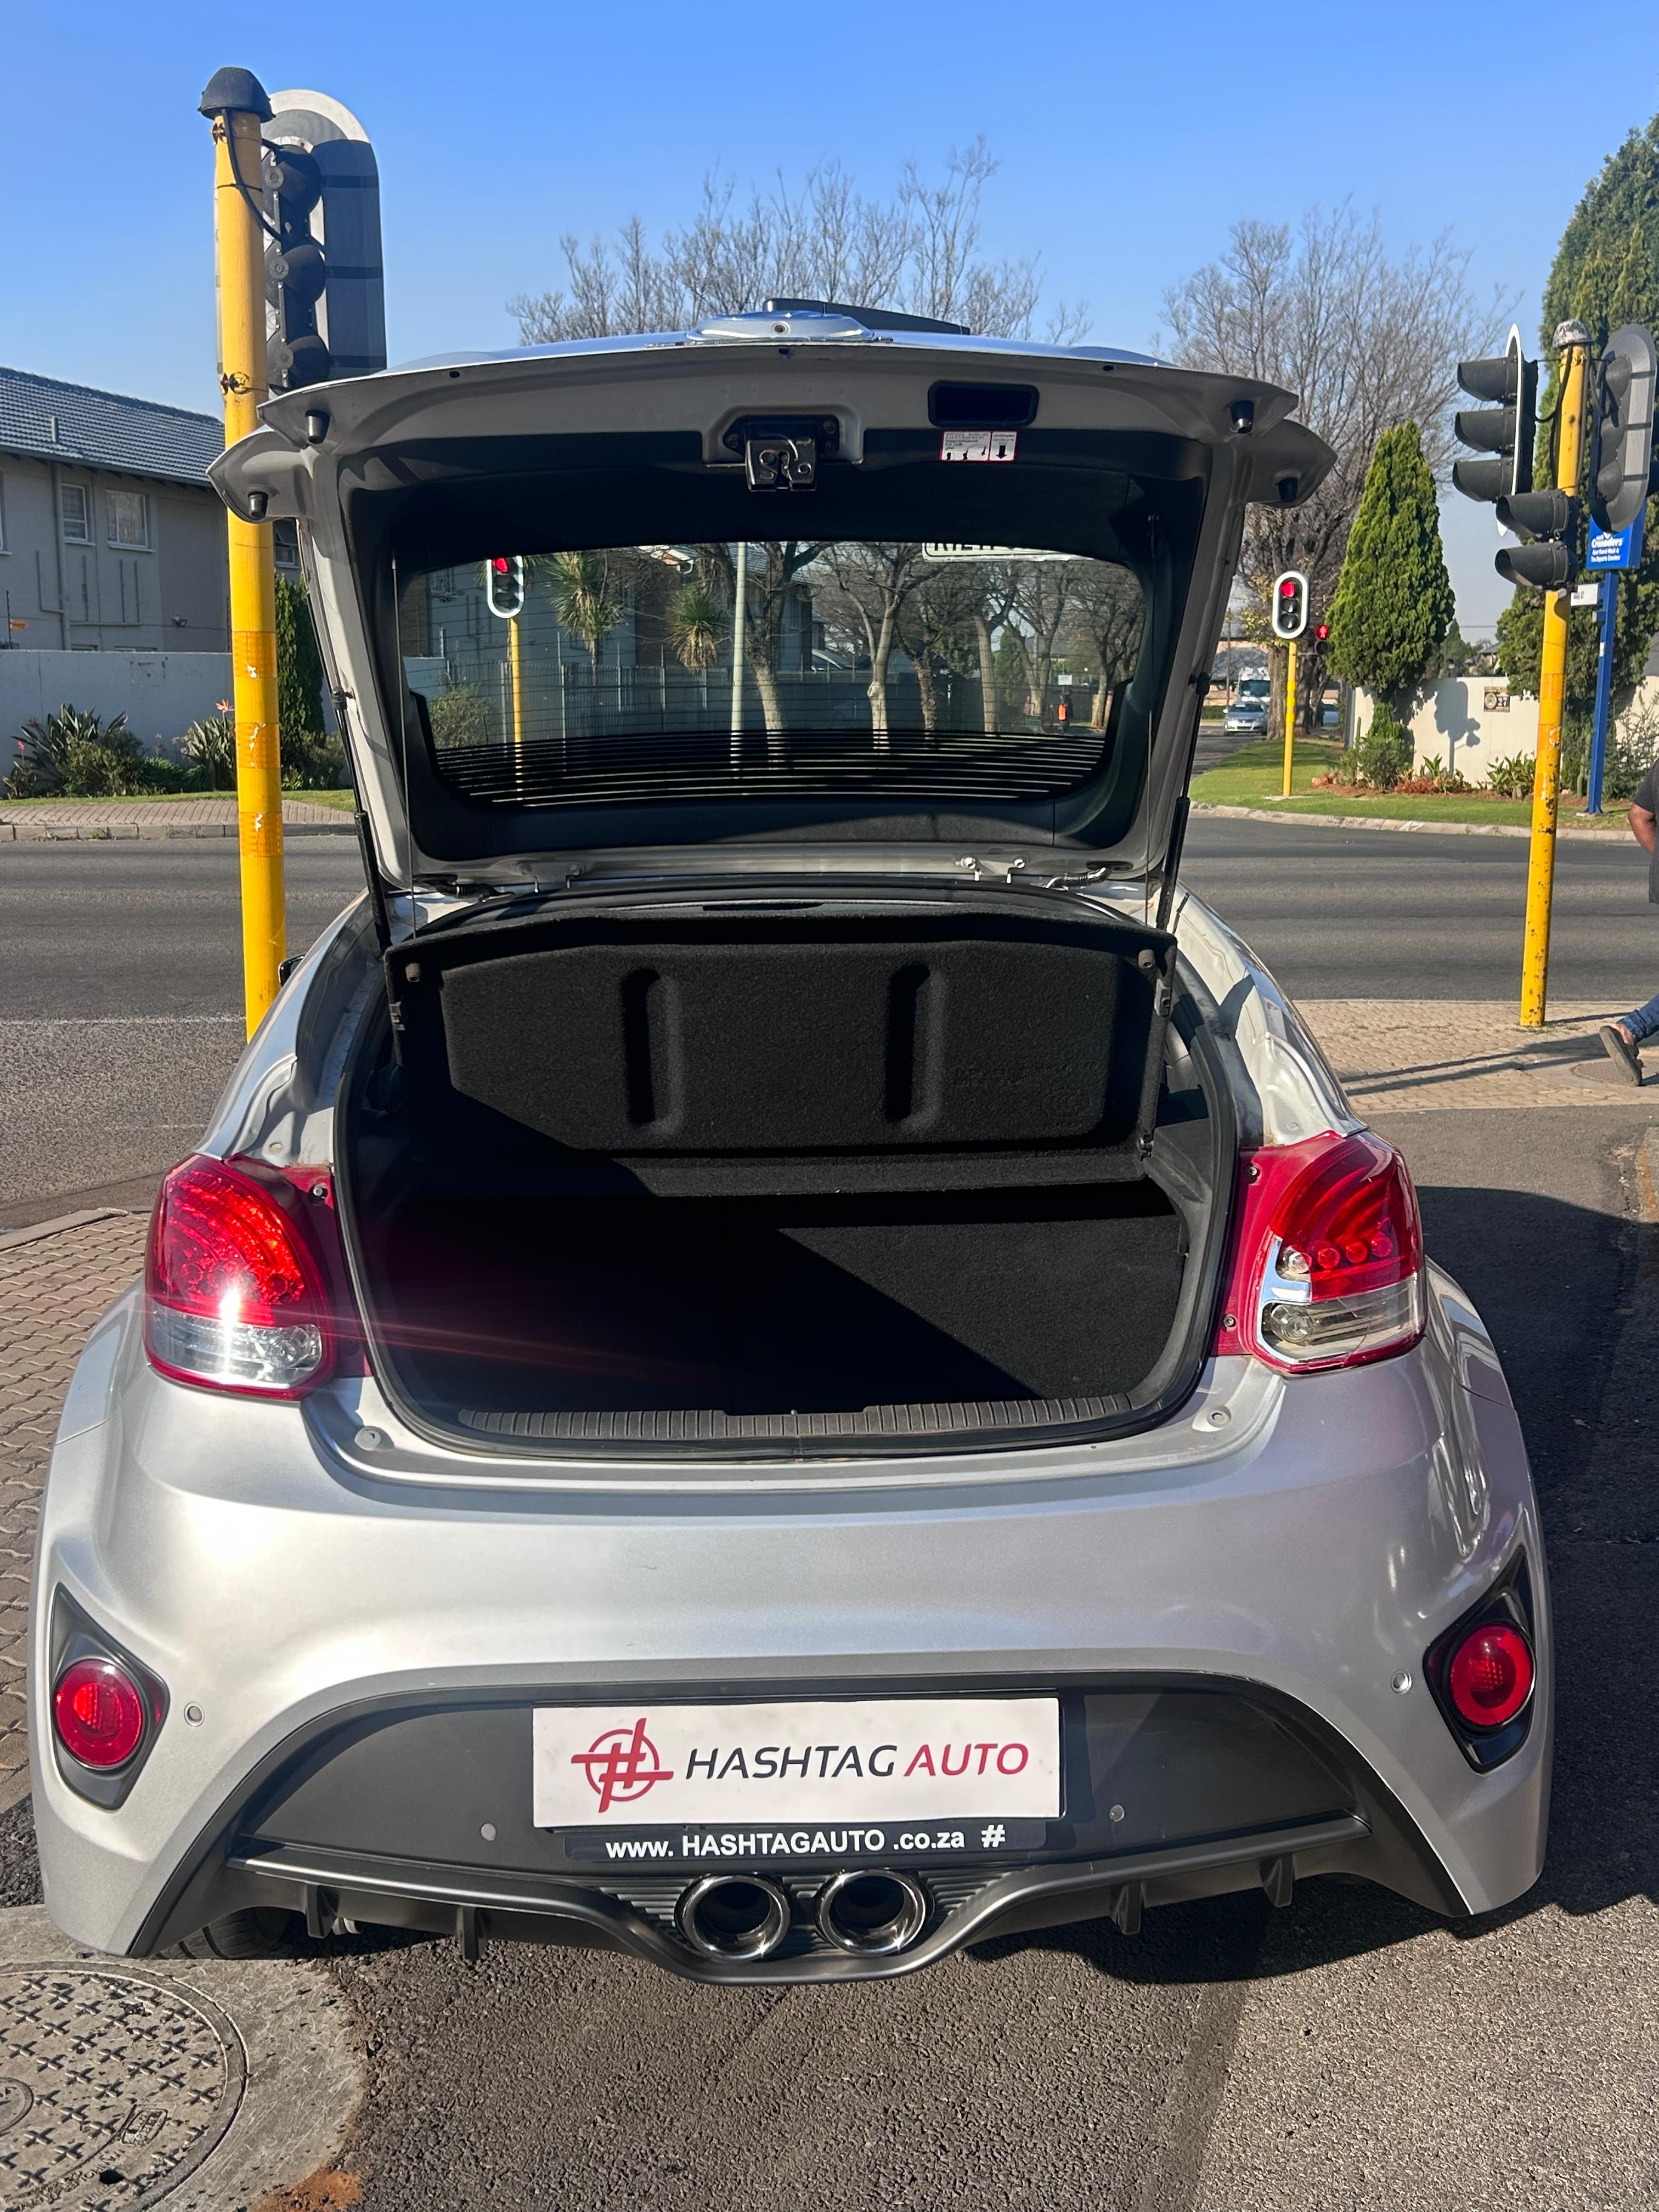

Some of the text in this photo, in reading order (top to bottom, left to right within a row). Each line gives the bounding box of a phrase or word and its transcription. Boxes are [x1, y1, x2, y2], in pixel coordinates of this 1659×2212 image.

[686, 1742, 1029, 1780] HASHTAG AUTO
[606, 1841, 674, 1859] www.
[682, 1829, 885, 1857] HASHTAGAUTO
[893, 1831, 965, 1850] .co.za
